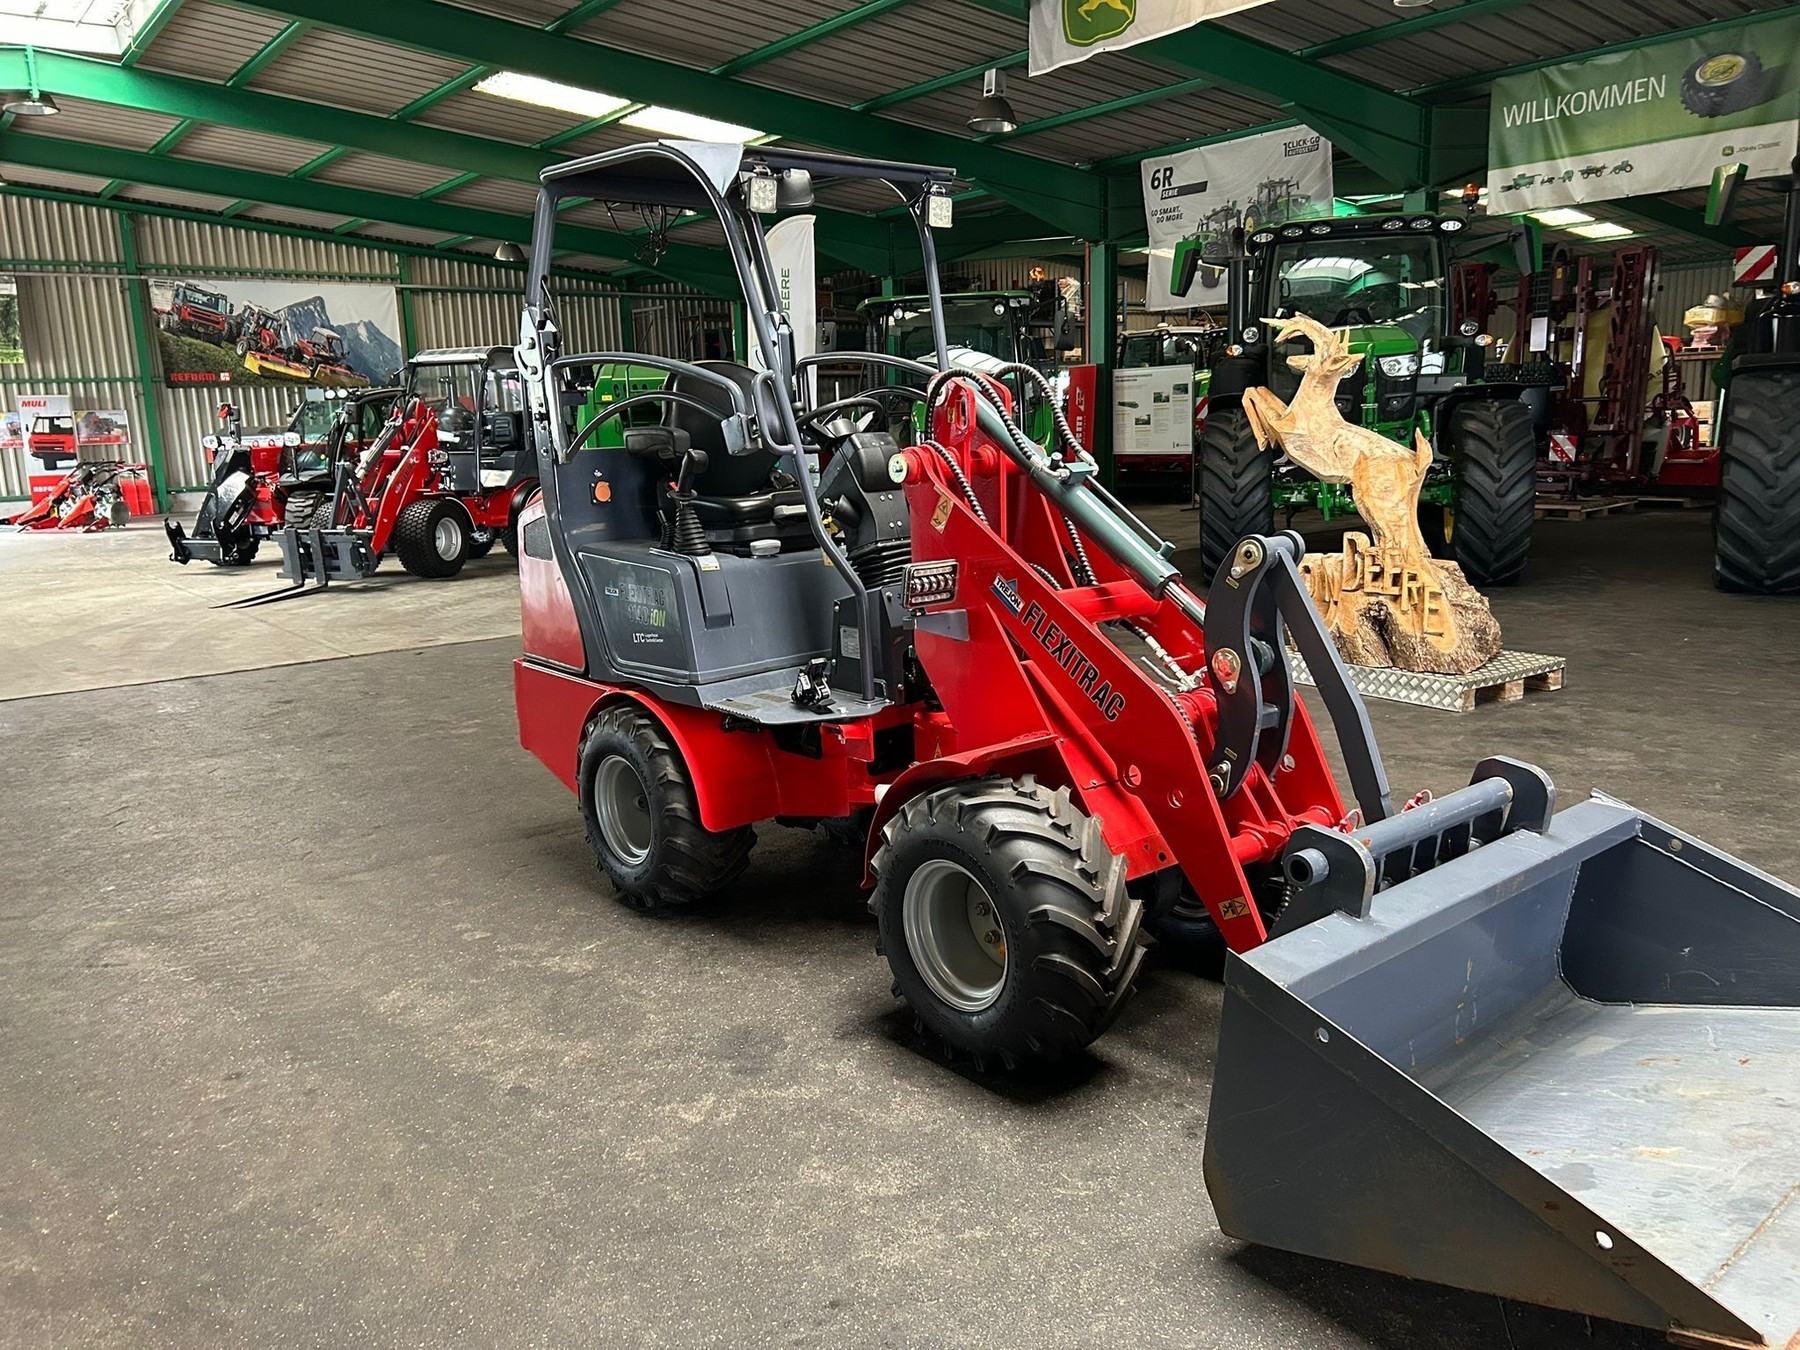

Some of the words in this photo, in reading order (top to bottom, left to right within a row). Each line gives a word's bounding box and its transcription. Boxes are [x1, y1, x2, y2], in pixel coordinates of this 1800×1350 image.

[1503, 74, 1666, 127] WILLKOMMEN
[1151, 166, 1174, 190] 6R
[1162, 188, 1179, 199] SERIE
[994, 576, 1023, 611] TREJON
[632, 633, 646, 643] LTC
[1021, 600, 1126, 722] FLEXITRAC
